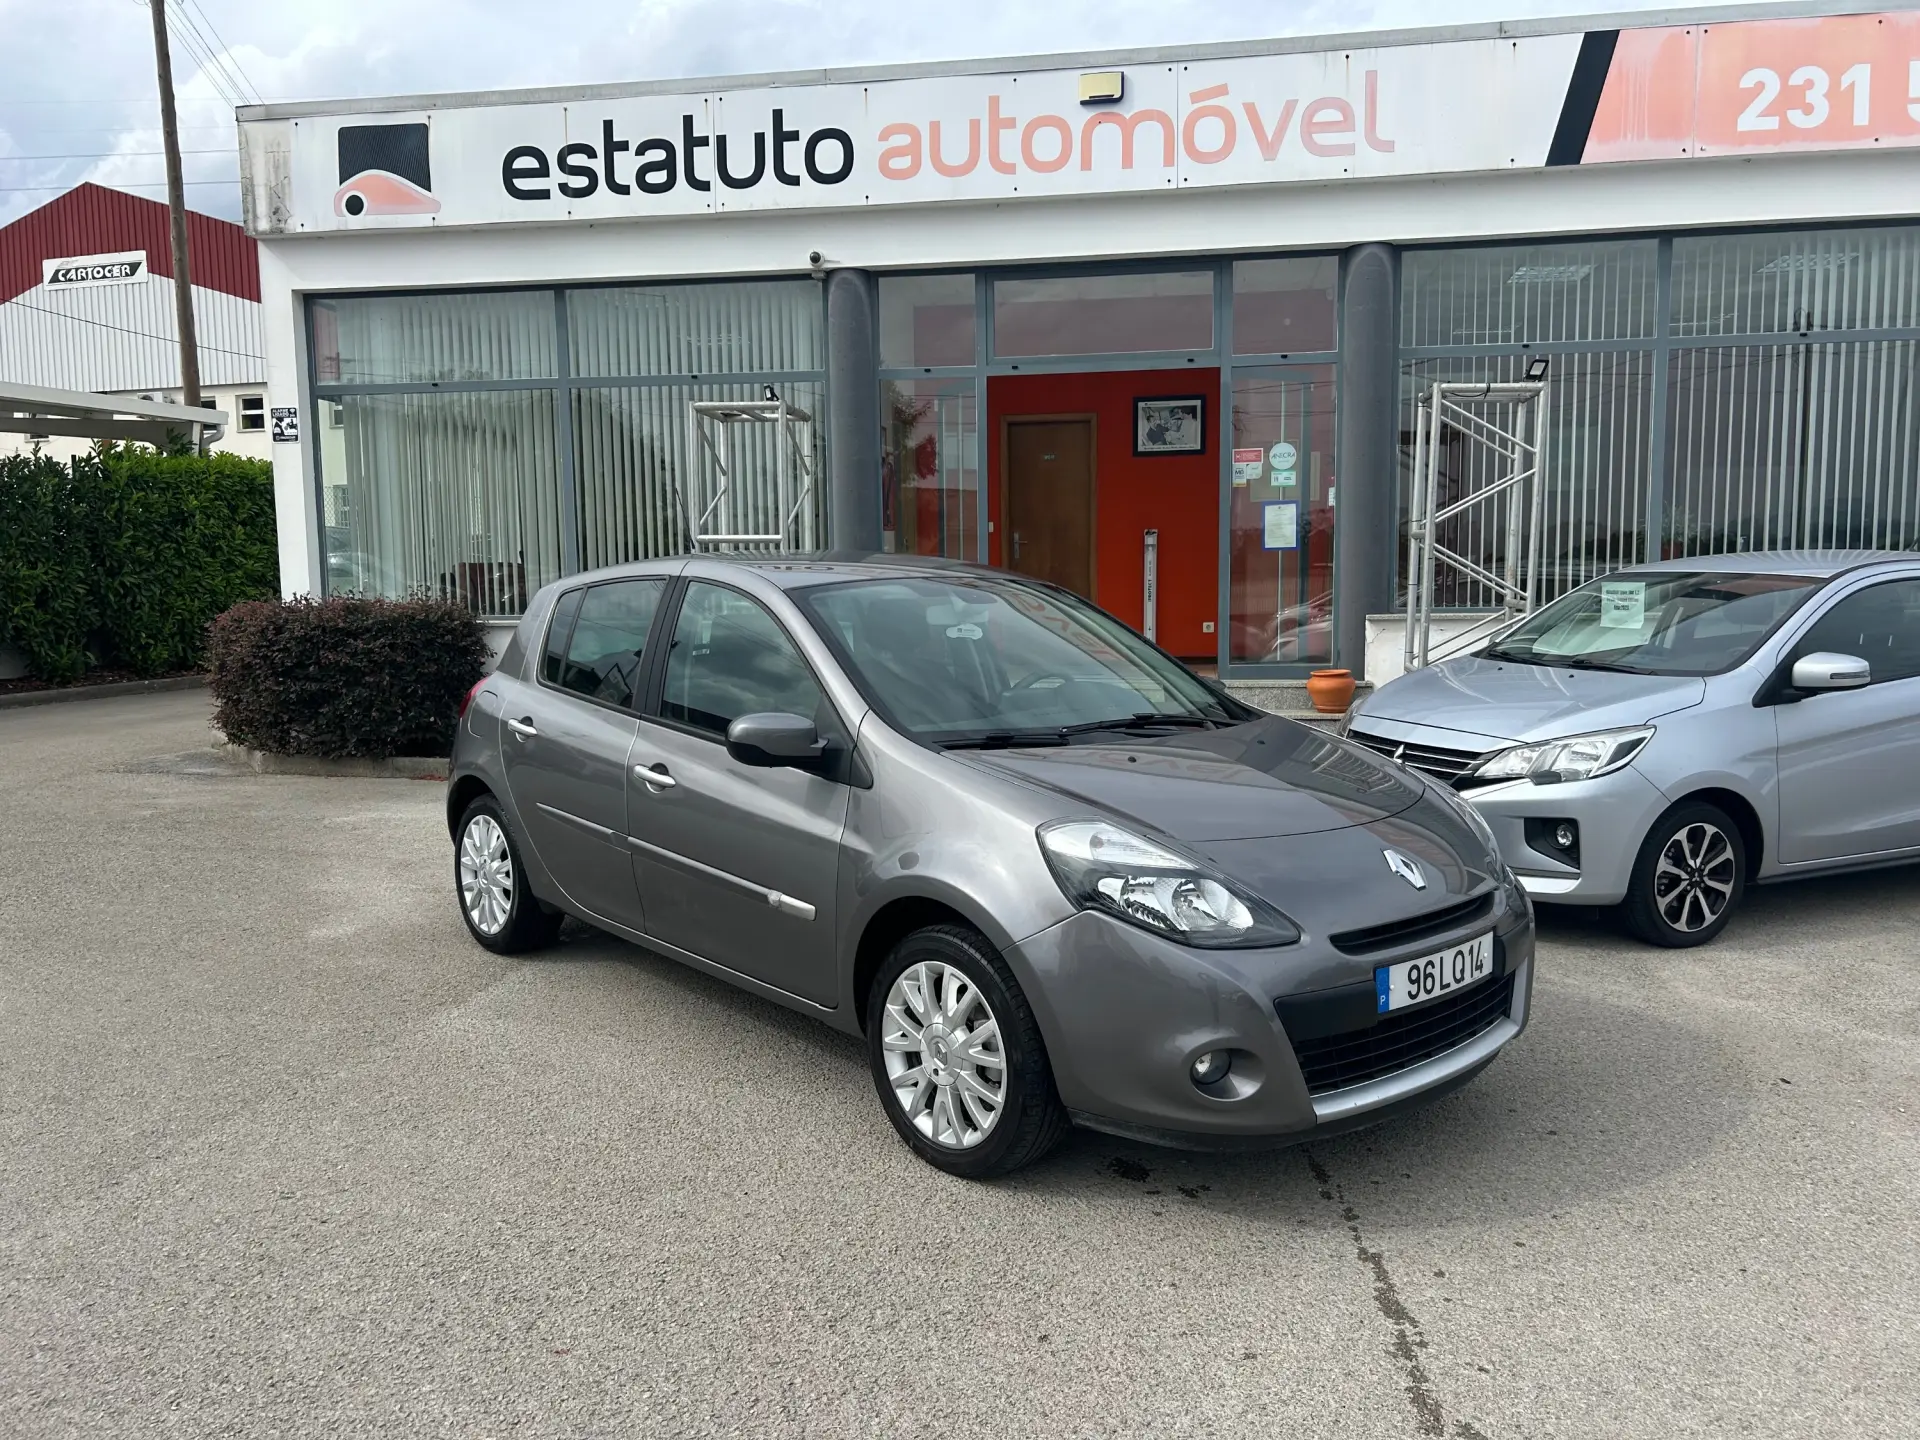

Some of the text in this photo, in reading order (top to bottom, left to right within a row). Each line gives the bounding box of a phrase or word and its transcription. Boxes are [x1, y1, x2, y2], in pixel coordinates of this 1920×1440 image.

[1736, 63, 1872, 132] 231
[501, 108, 855, 200] estatuto
[57, 264, 131, 281] CARTOCER
[1380, 995, 1386, 1006] P
